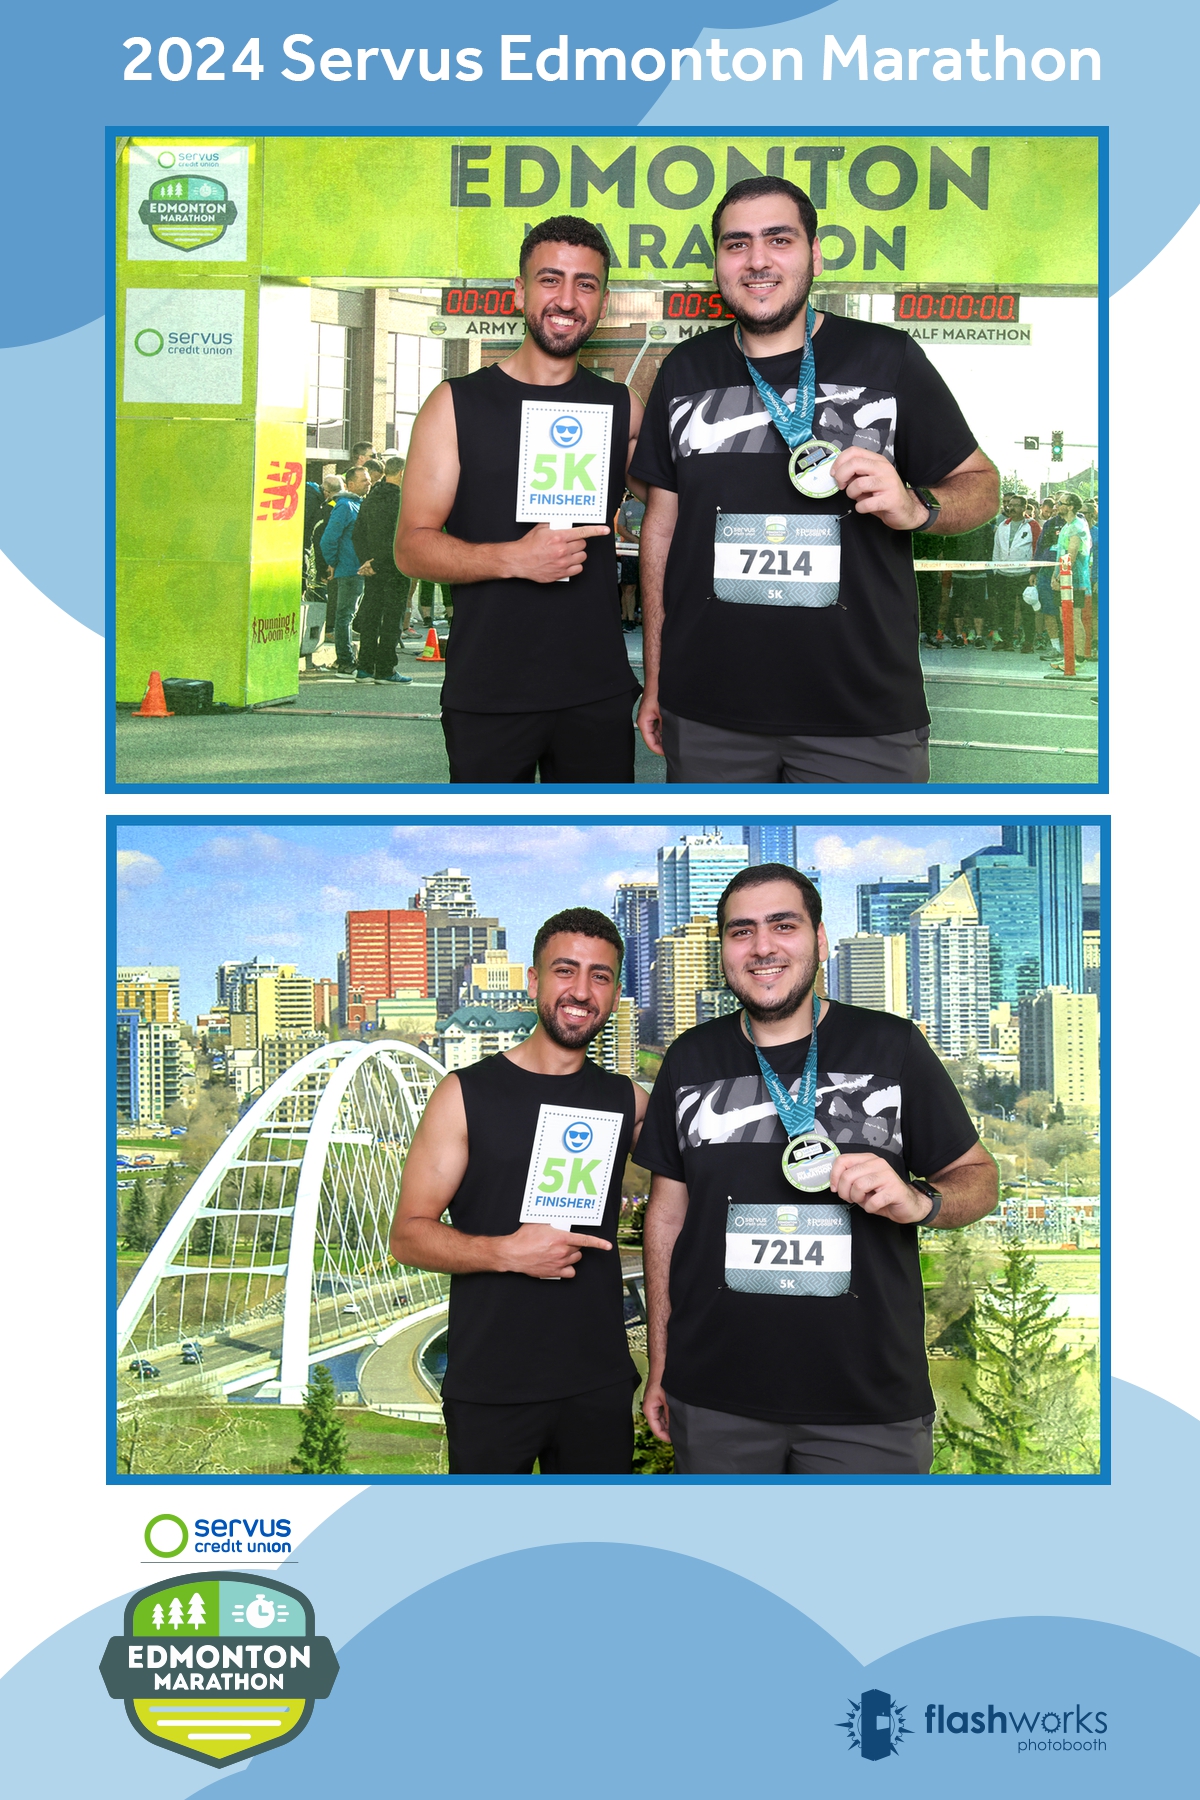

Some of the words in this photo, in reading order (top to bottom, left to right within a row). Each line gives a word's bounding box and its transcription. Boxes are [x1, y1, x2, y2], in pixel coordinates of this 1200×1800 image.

[178, 152, 220, 161] servus
[149, 202, 227, 214] EDMONTON
[160, 214, 215, 222] MARATHON
[465, 321, 517, 336] ARMY
[942, 328, 1031, 341] MARATHON
[167, 332, 233, 345] servus
[167, 345, 200, 355] credit
[202, 347, 233, 355] union
[529, 452, 598, 491] 5K
[529, 493, 596, 506] FINISHER!
[739, 549, 812, 576] 7214
[767, 589, 783, 599] 5K
[257, 613, 290, 644] Running
[537, 1157, 603, 1195] 5K
[534, 1195, 596, 1209] FINISHER!
[751, 1239, 824, 1266] 7214
[780, 1279, 796, 1289] 5K
